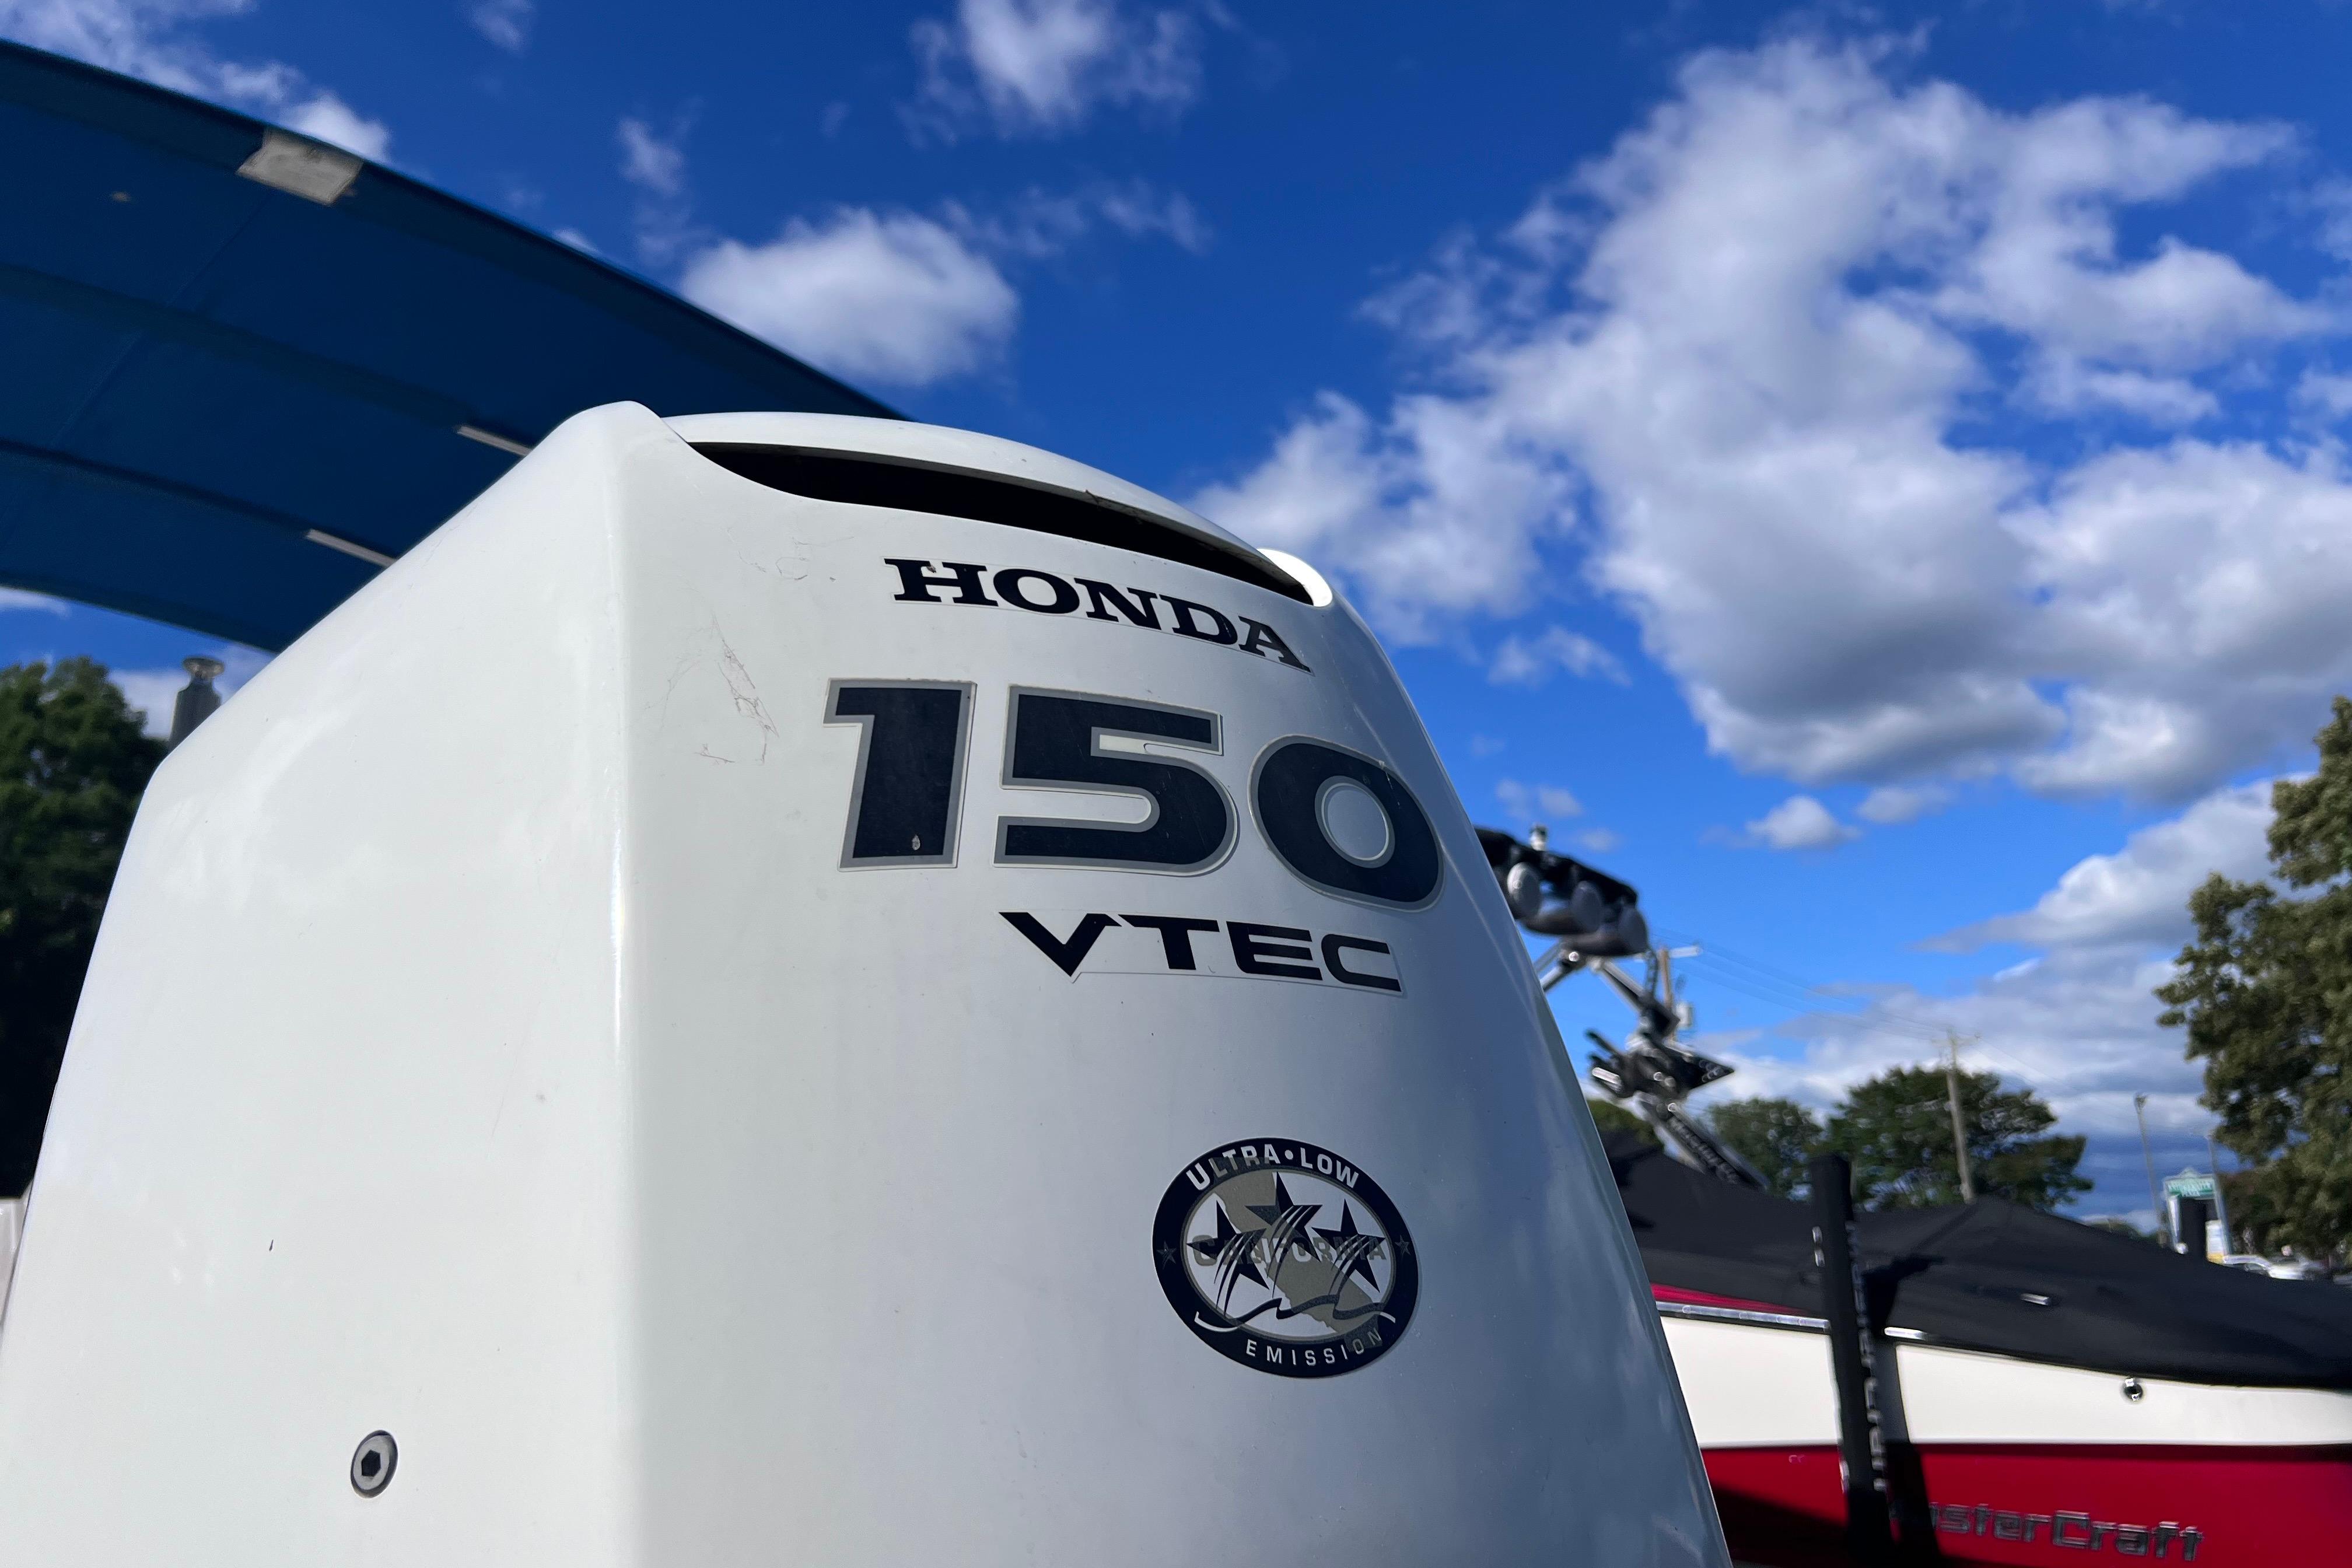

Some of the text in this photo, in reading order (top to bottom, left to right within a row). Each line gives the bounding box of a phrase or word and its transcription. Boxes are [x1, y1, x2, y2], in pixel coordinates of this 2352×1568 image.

[883, 558, 1311, 673] HONDA
[823, 678, 1444, 912] 150
[999, 911, 1401, 992] VTEC
[1192, 1234, 1387, 1266] CALIFORNIA
[1245, 1328, 1382, 1366] EMISSION
[1928, 1502, 2203, 1562] sterCraft
